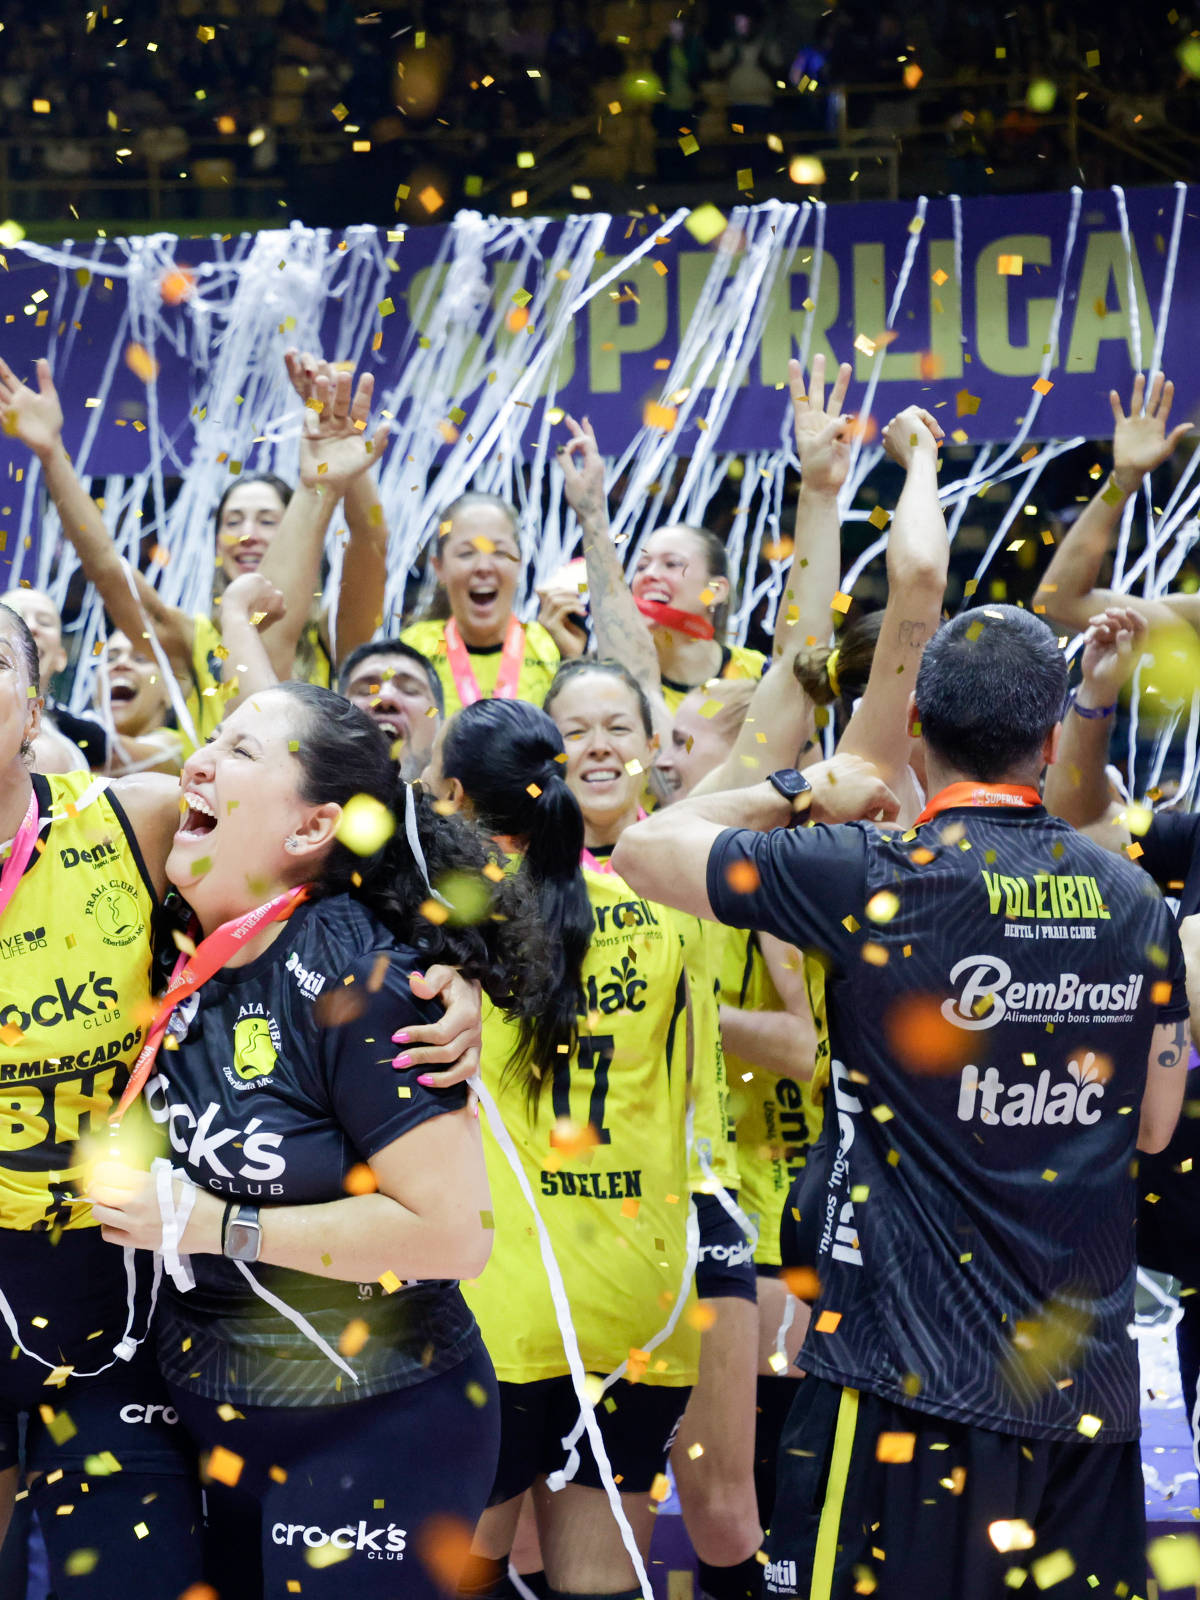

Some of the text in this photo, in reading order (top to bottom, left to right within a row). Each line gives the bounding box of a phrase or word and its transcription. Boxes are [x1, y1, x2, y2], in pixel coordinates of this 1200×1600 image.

[60, 841, 116, 869] Dent
[86, 879, 138, 915] PRAIA CLUBE
[981, 870, 1111, 920] VOLEIBOL
[231, 899, 277, 939] SUPERLIGA
[1004, 924, 1034, 939] DENTIL
[1041, 925, 1069, 939] PRAIA
[1070, 926, 1096, 939] CLUBE
[1, 944, 26, 960] LIFE
[587, 974, 648, 1015] lac
[941, 954, 1144, 1031] BemBrasil
[83, 1010, 121, 1030] CLUB
[266, 1010, 282, 1053] UBE
[1004, 1011, 1134, 1024] Alimentando bons momentos
[957, 1060, 1104, 1127] Italac
[144, 1073, 287, 1181] ock's
[208, 1178, 284, 1195] CLUB
[541, 1169, 642, 1199] SUELEN
[819, 1193, 837, 1255] sorriu.
[119, 1403, 179, 1425] cro
[271, 1520, 407, 1551] crock's
[367, 1552, 404, 1561] CLUB
[763, 1560, 797, 1586] entil
